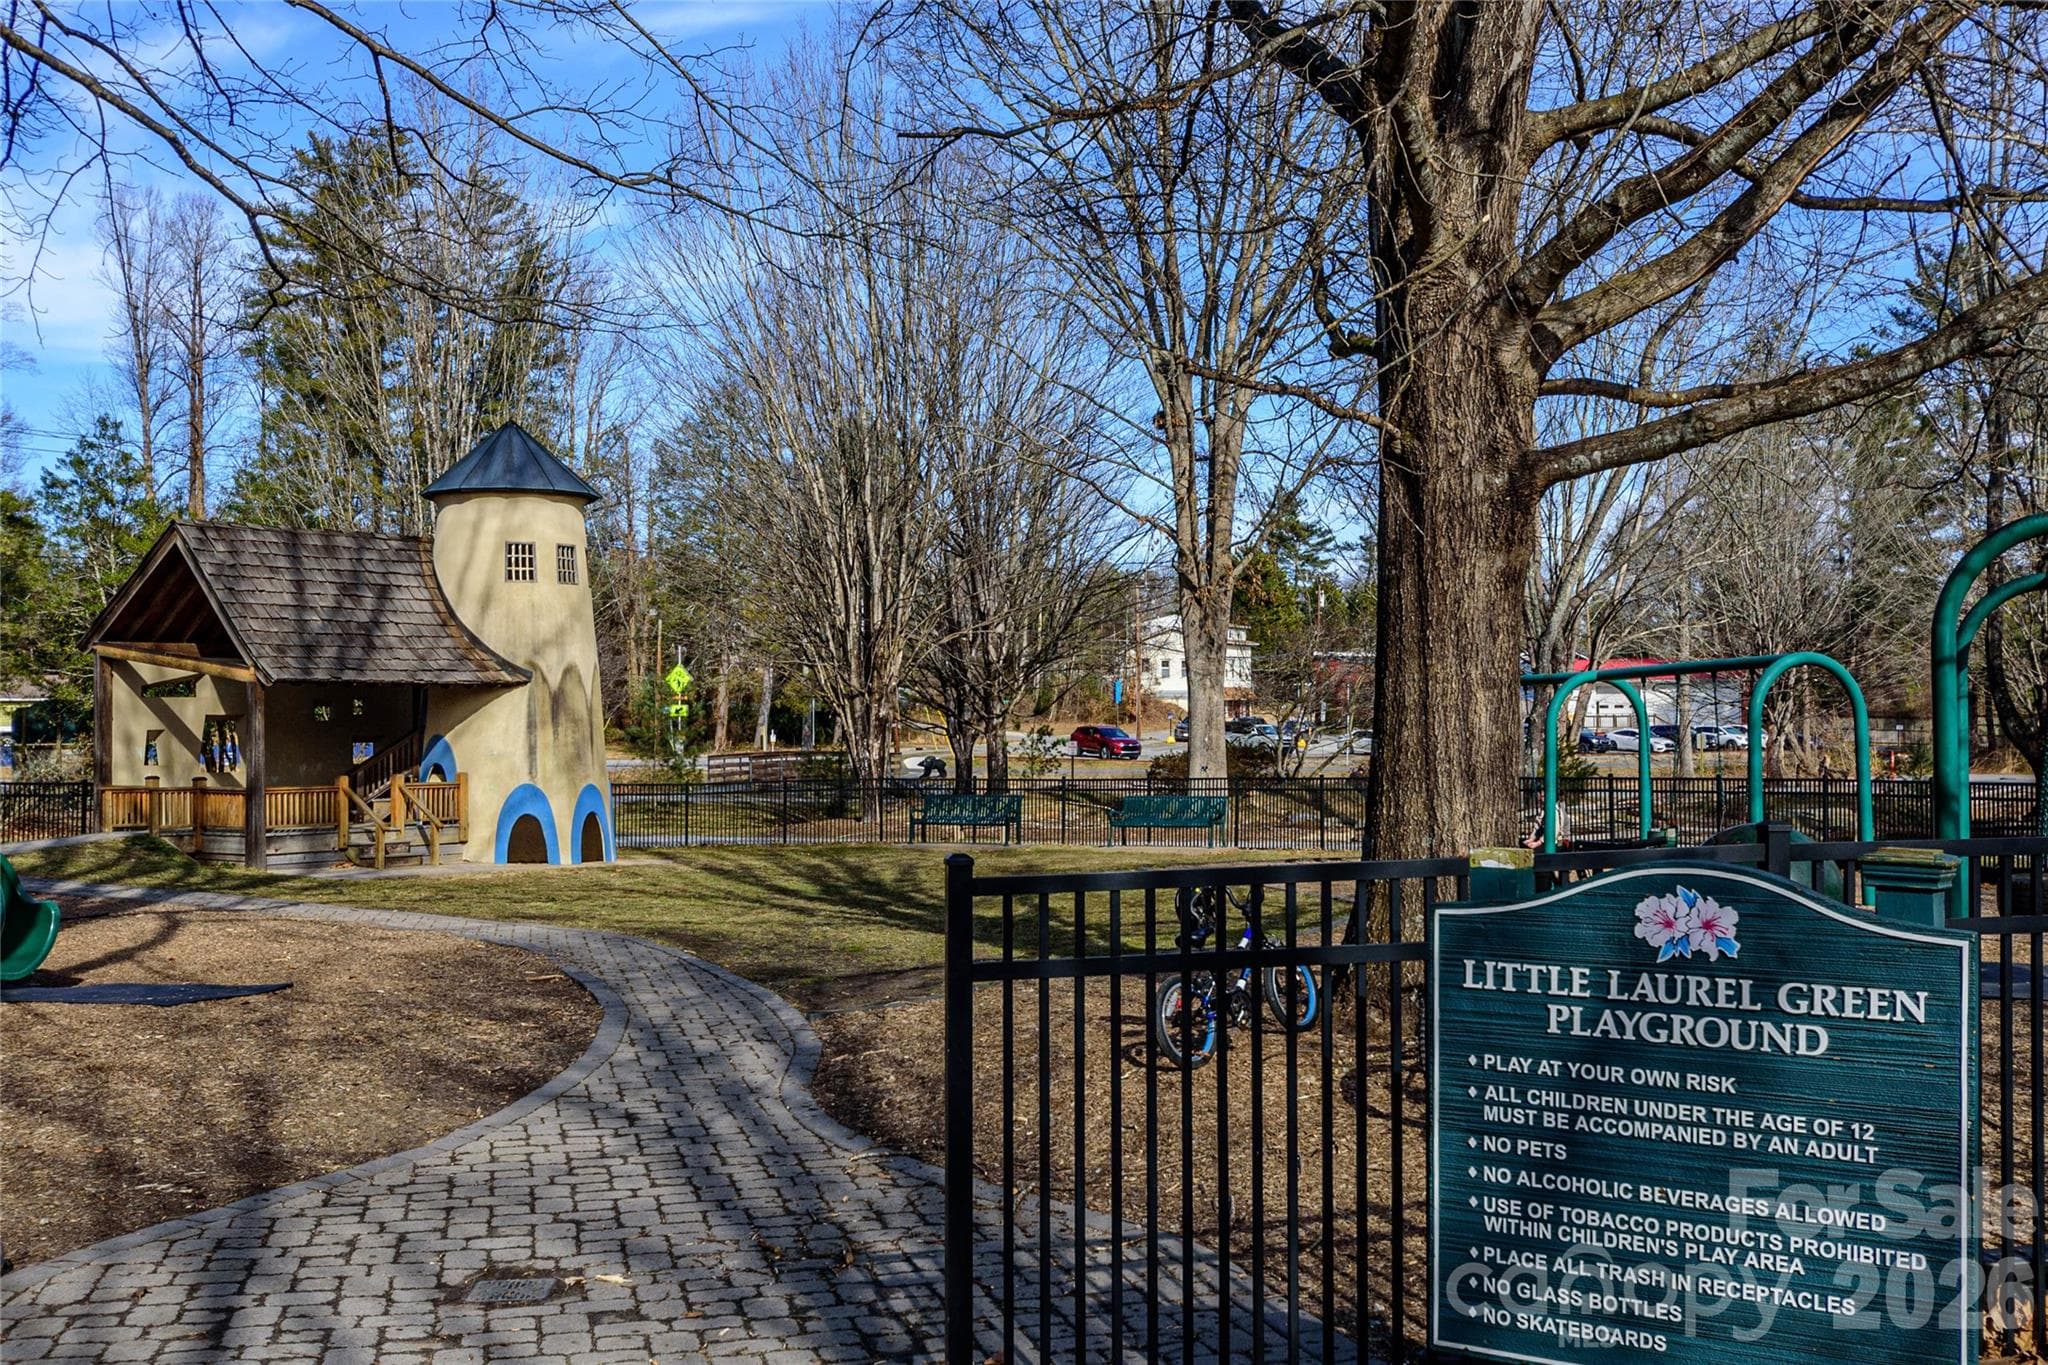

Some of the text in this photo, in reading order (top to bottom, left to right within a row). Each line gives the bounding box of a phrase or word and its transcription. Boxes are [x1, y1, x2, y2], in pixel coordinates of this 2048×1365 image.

[1462, 959, 1929, 1024] LITTLE LAUREL GREEN
[1547, 1004, 1829, 1056] PLAYGROUND
[1483, 1054, 1736, 1094] PLAY AT YOUR OWN RISK
[1483, 1105, 1879, 1164] MUST BE ACCOMPANIED BY AN ADULT
[1484, 1085, 1875, 1141] ALL CHILDREN UNDER THE AGE OF 12
[1483, 1135, 1568, 1160] NO PETS
[1483, 1166, 1886, 1232] NO ALCOHOLIC BEVERAGES ALLOWED
[1483, 1196, 1927, 1271] USE OF TOBACCO PRODUCTS PROHIBITED
[1484, 1215, 1805, 1275] WITHIN CHILDREN'S PLAY AREA
[1483, 1246, 1856, 1315] PLACE ALL TRASH IN RECEPTACLES
[1483, 1277, 1683, 1322] NO GLASS BOTTLES
[1483, 1307, 1667, 1352] NO SKATEBOARDS
